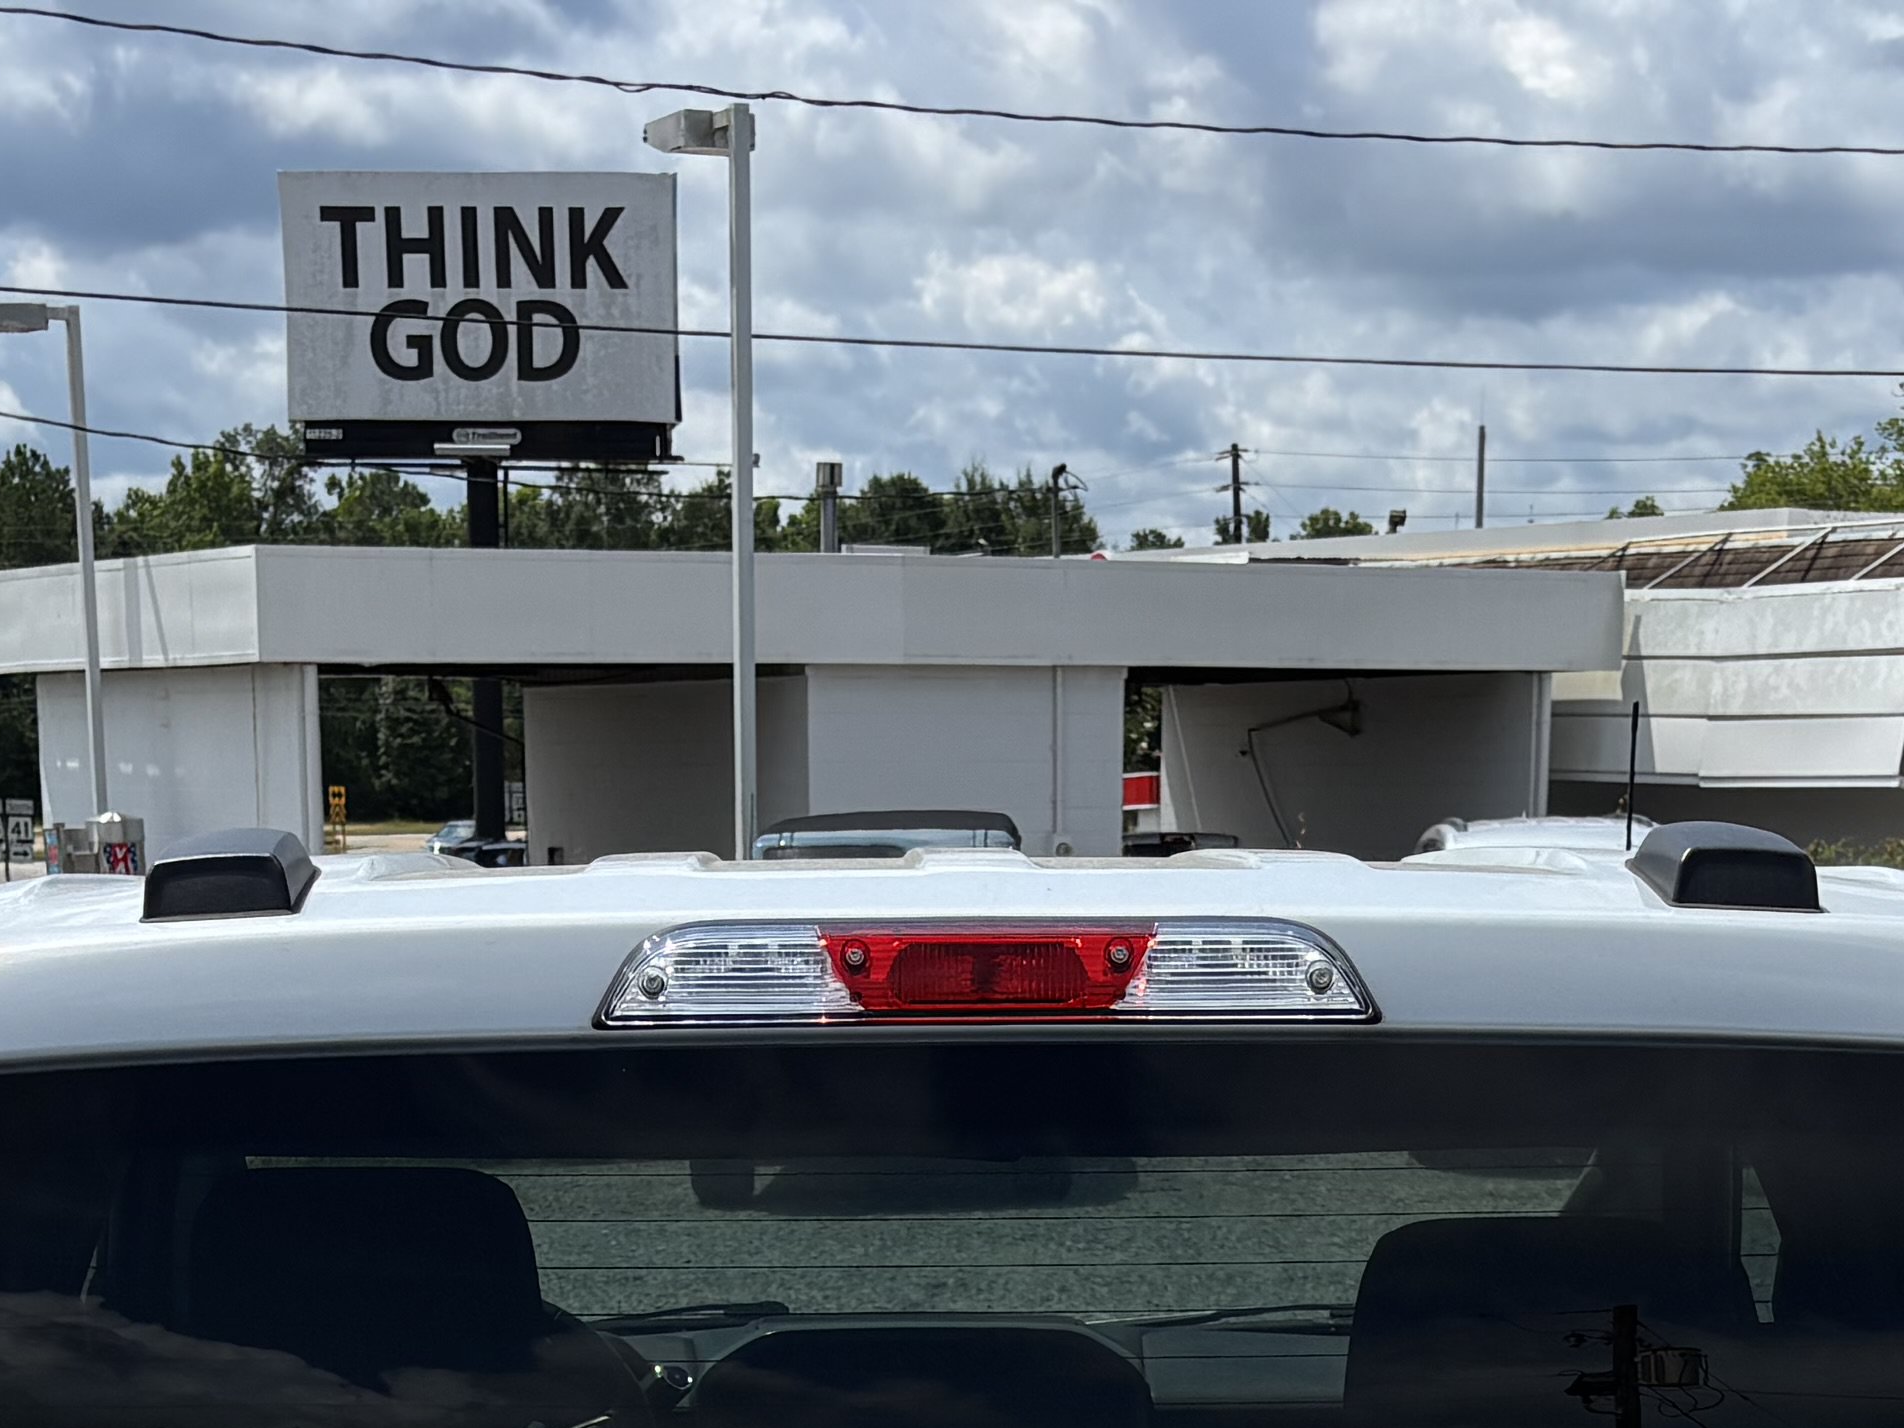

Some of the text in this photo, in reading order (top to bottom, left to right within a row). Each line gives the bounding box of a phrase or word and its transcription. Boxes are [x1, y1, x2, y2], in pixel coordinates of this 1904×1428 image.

[319, 205, 629, 290] THINK
[369, 298, 581, 382] GOD
[11, 821, 29, 838] 41
